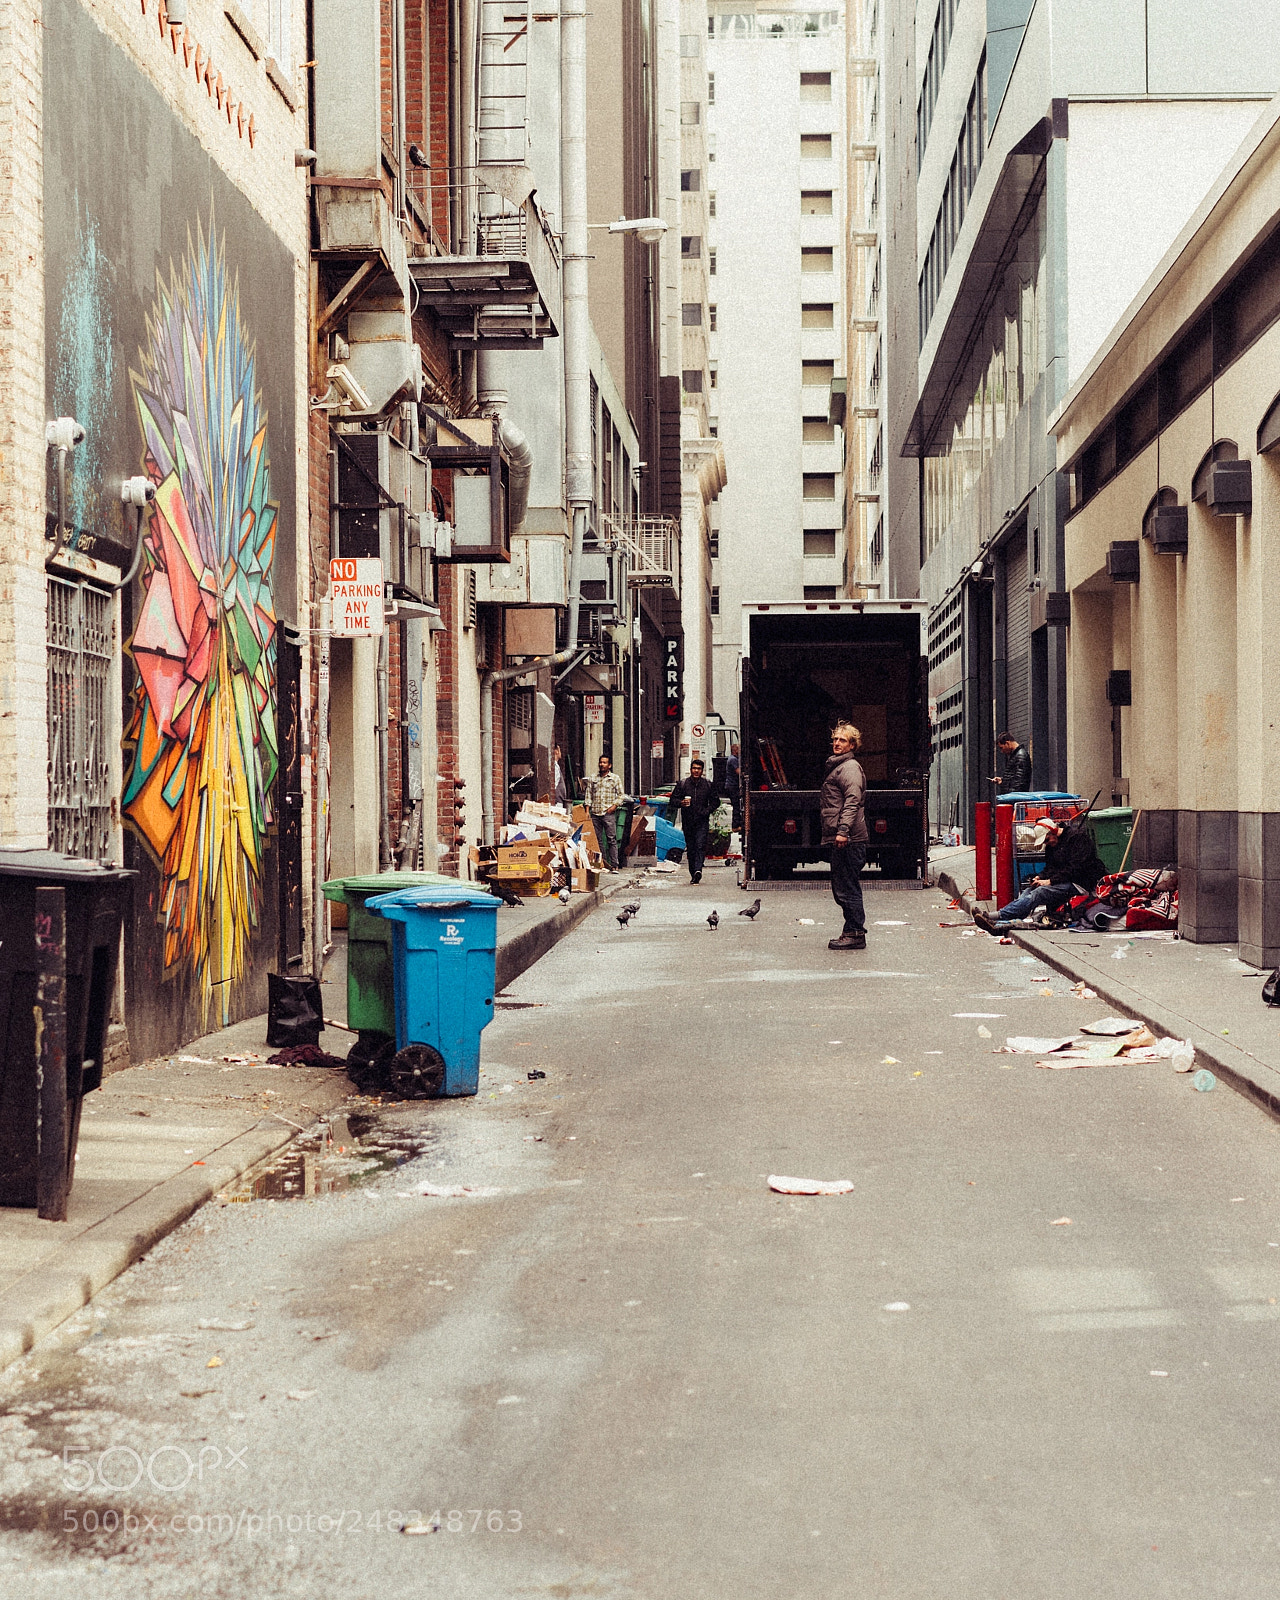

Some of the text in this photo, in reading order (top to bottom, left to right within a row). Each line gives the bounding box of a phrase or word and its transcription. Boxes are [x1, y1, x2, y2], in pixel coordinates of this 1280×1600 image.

[333, 561, 355, 579] NO
[334, 584, 381, 597] PARKING
[345, 601, 368, 613] ANY
[344, 616, 370, 629] TIME
[666, 640, 679, 698] PARK
